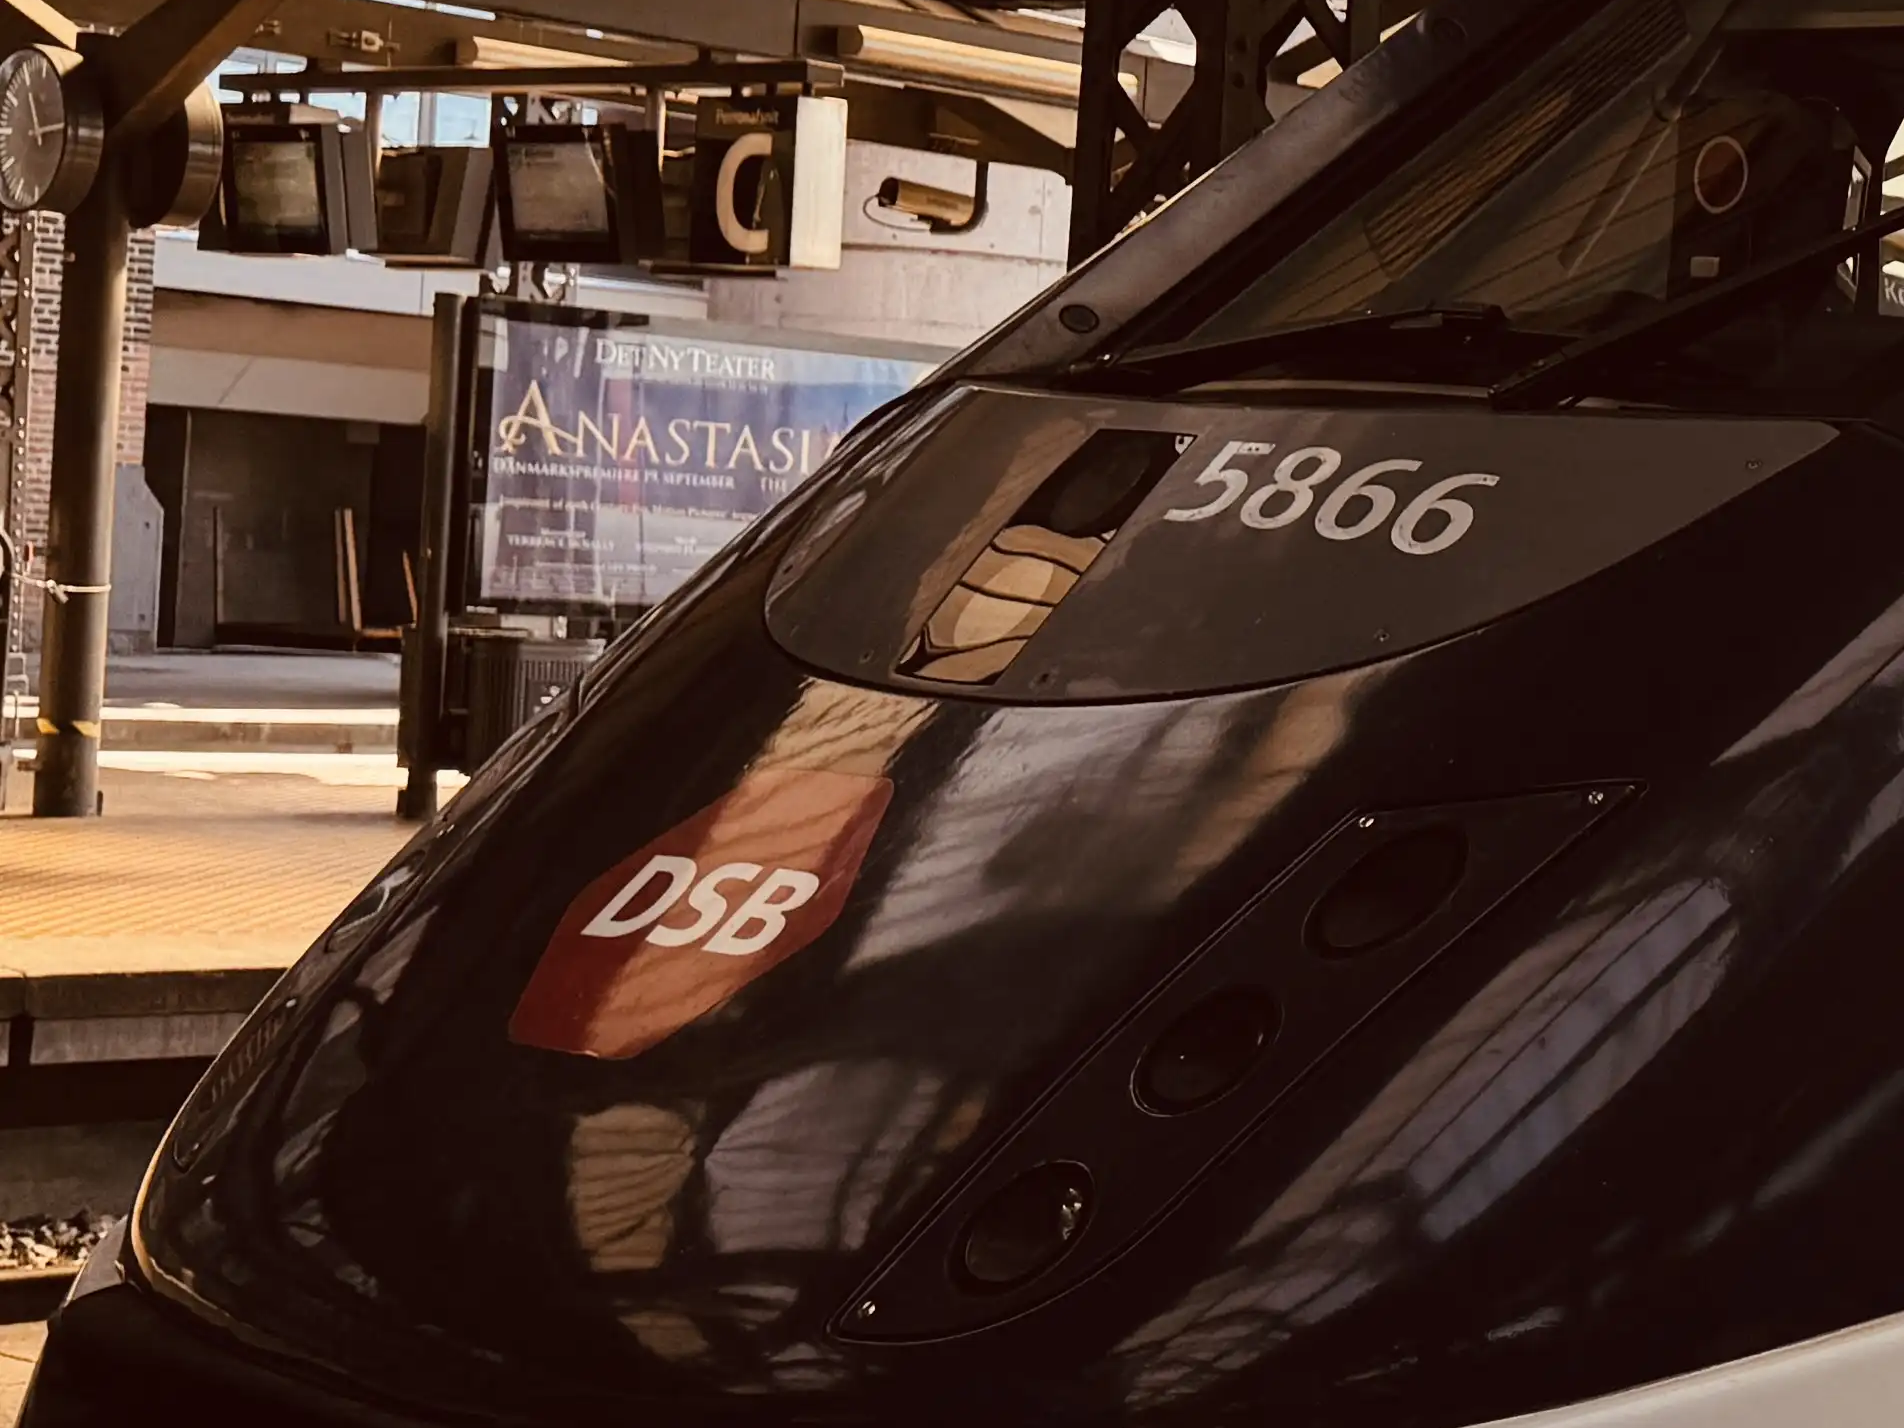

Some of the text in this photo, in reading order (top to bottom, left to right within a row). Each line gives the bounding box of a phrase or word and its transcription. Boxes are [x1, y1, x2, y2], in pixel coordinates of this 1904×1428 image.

[716, 132, 773, 253] C
[596, 338, 775, 380] DET NY TEATER
[663, 471, 735, 489] SEPTEMBER
[1163, 441, 1500, 555] 5866
[580, 855, 819, 955] DSB
